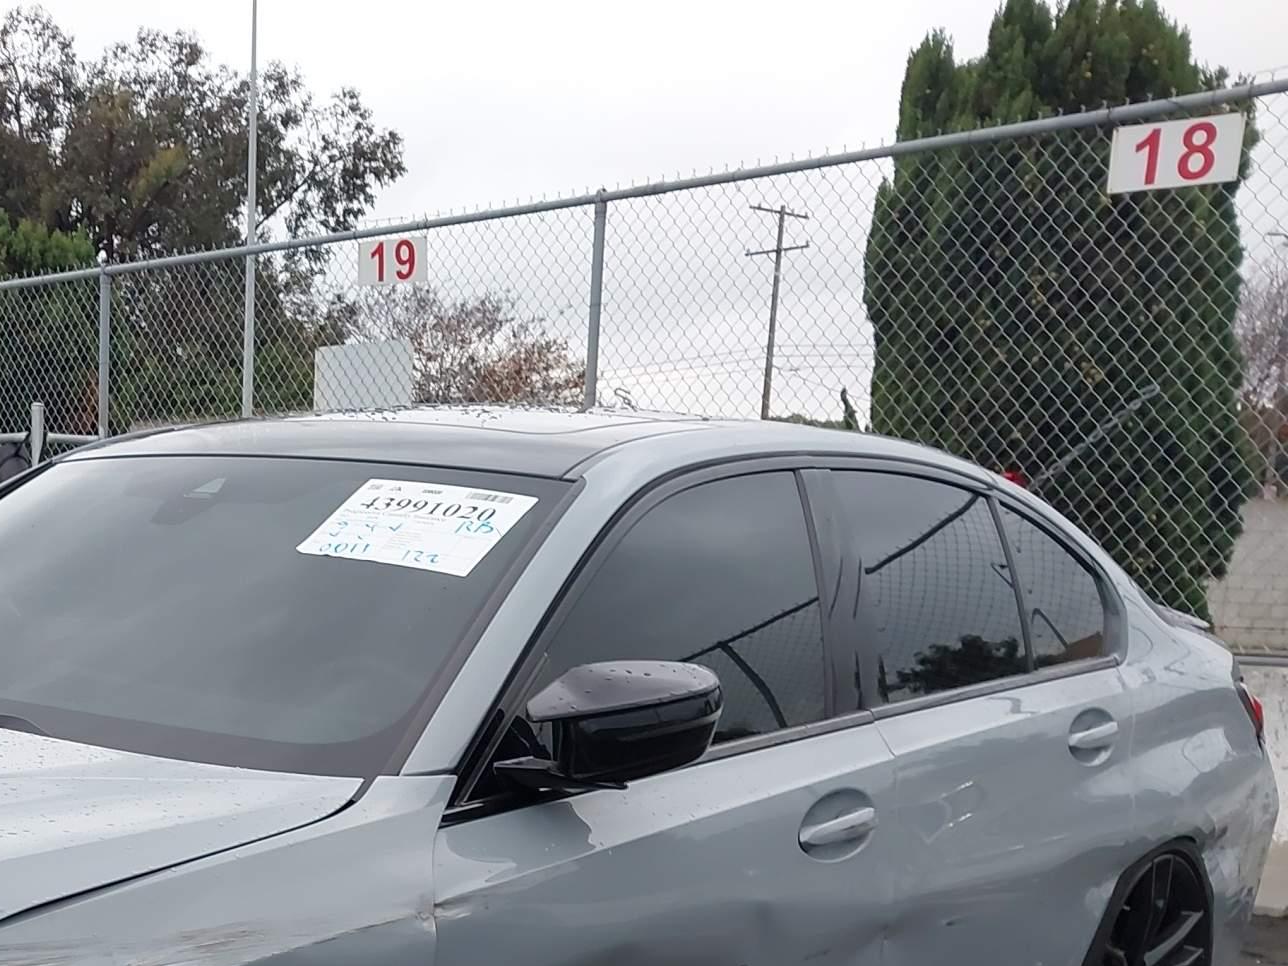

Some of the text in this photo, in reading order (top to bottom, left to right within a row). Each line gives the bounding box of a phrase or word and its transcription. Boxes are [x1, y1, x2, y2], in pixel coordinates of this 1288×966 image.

[1135, 122, 1217, 185] 18
[370, 239, 416, 282] 19
[360, 496, 497, 522] 43991020
